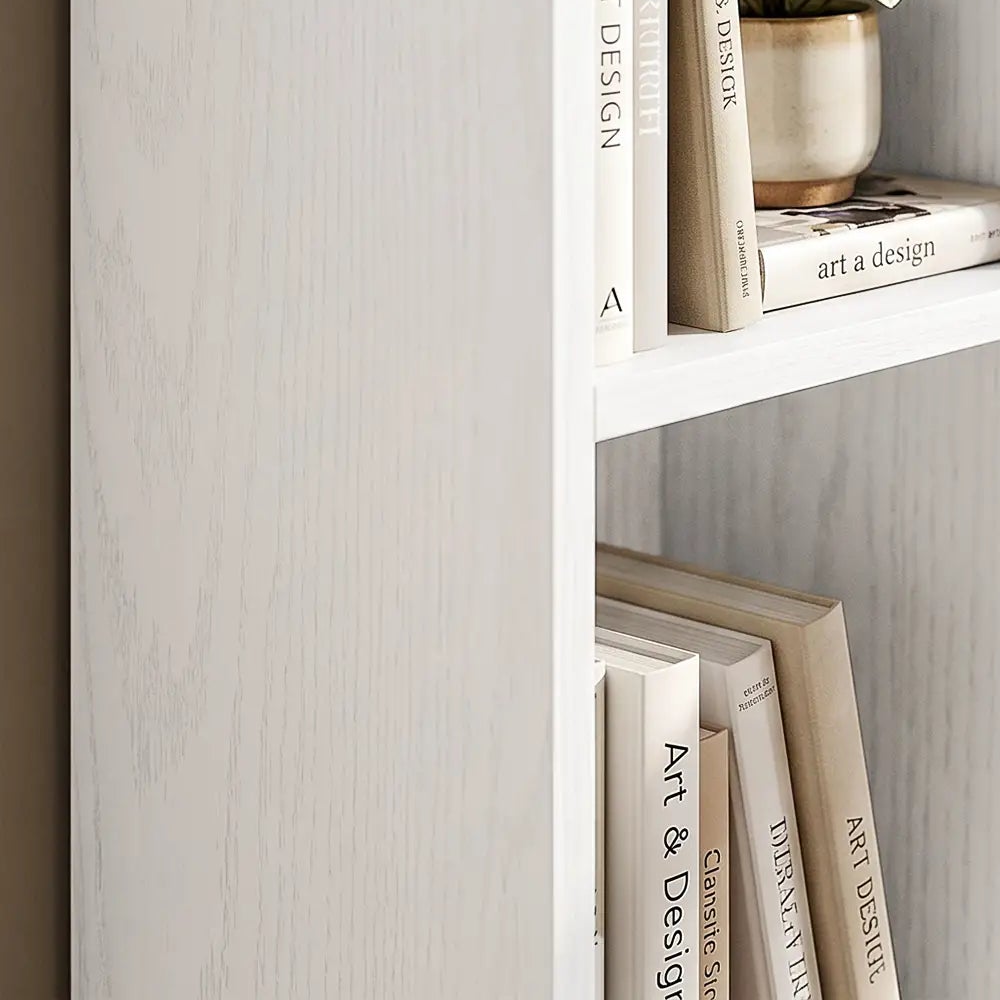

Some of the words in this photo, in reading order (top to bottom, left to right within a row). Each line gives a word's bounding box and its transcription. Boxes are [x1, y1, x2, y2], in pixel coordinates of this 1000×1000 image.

[600, 23, 622, 149] DESIGN
[817, 253, 847, 280] art
[853, 255, 865, 272] a
[872, 237, 936, 267] design
[600, 287, 623, 318] A
[663, 742, 689, 807] Art
[663, 826, 689, 859] &
[847, 817, 870, 869] ART
